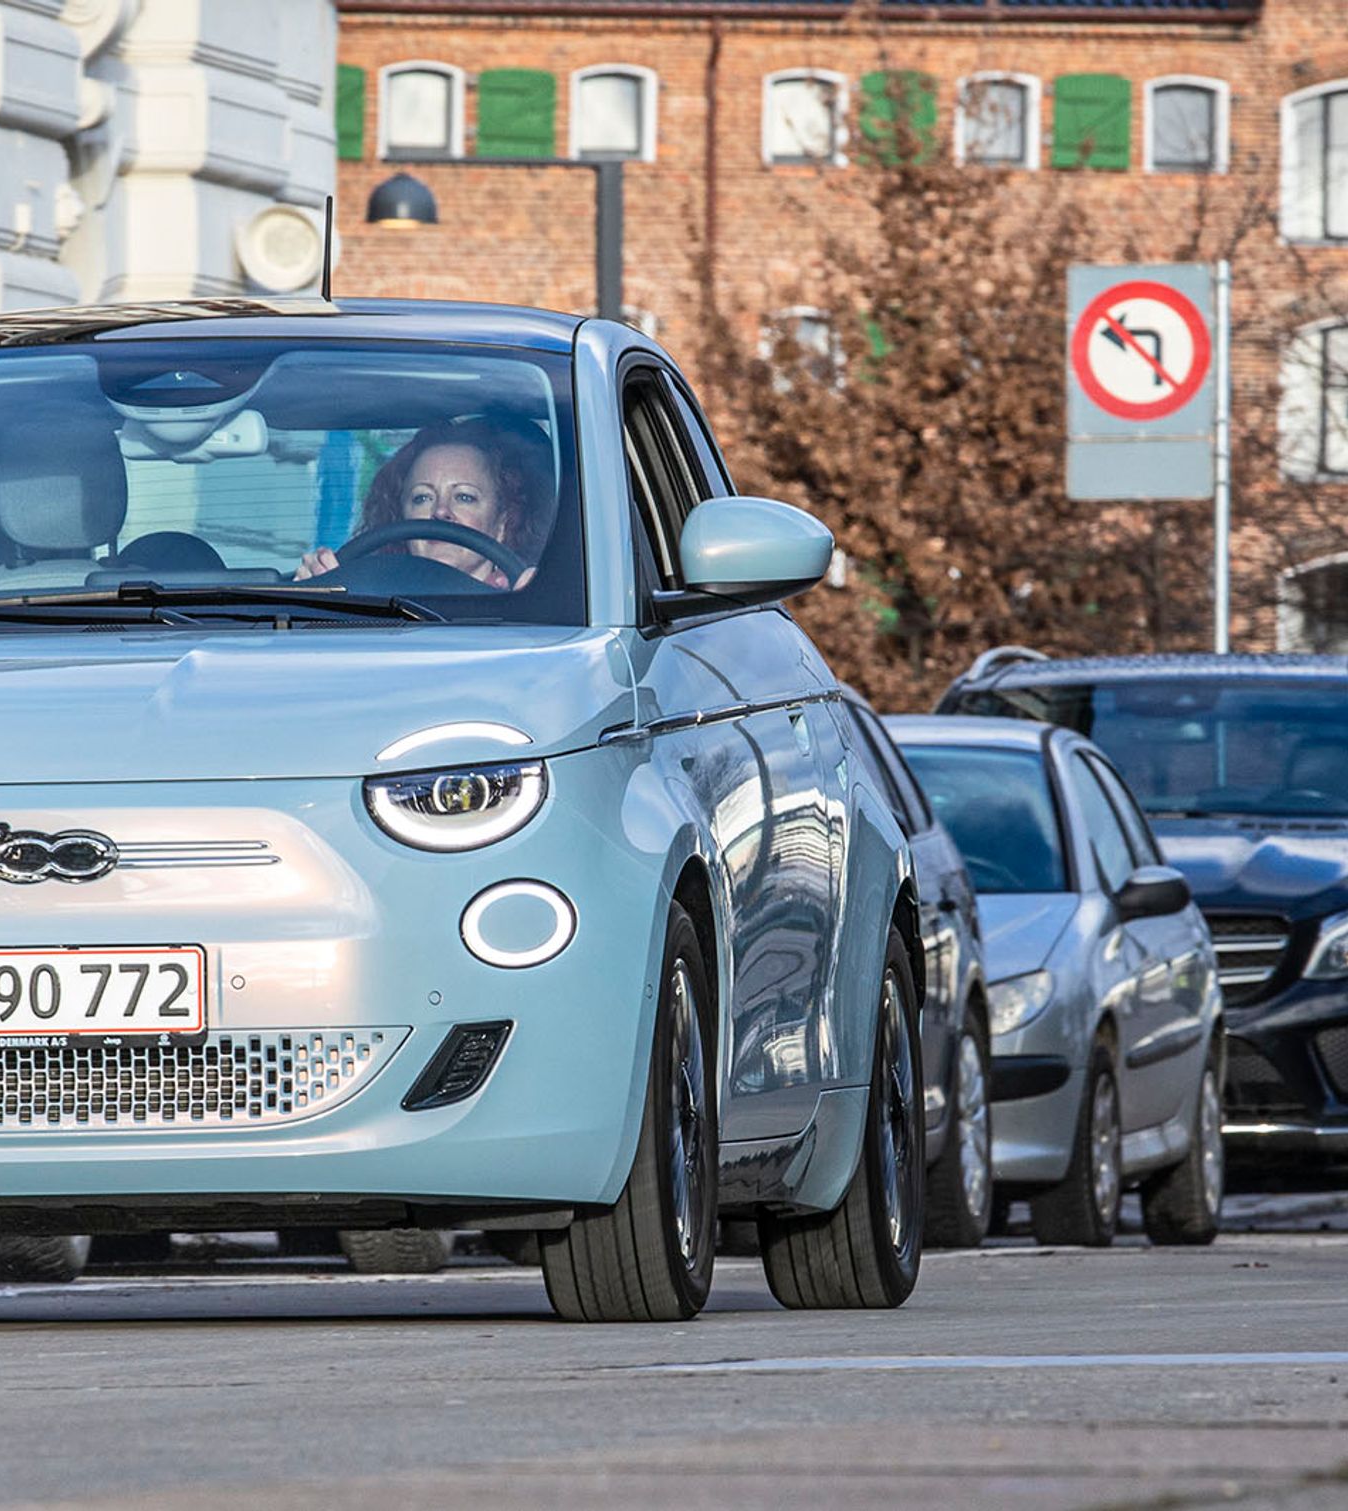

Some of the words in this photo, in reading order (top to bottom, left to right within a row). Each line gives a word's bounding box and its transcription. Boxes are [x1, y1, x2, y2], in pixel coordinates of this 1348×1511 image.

[79, 963, 190, 1018] 772
[0, 1037, 49, 1048] DENMARK
[50, 1037, 68, 1047] A/S
